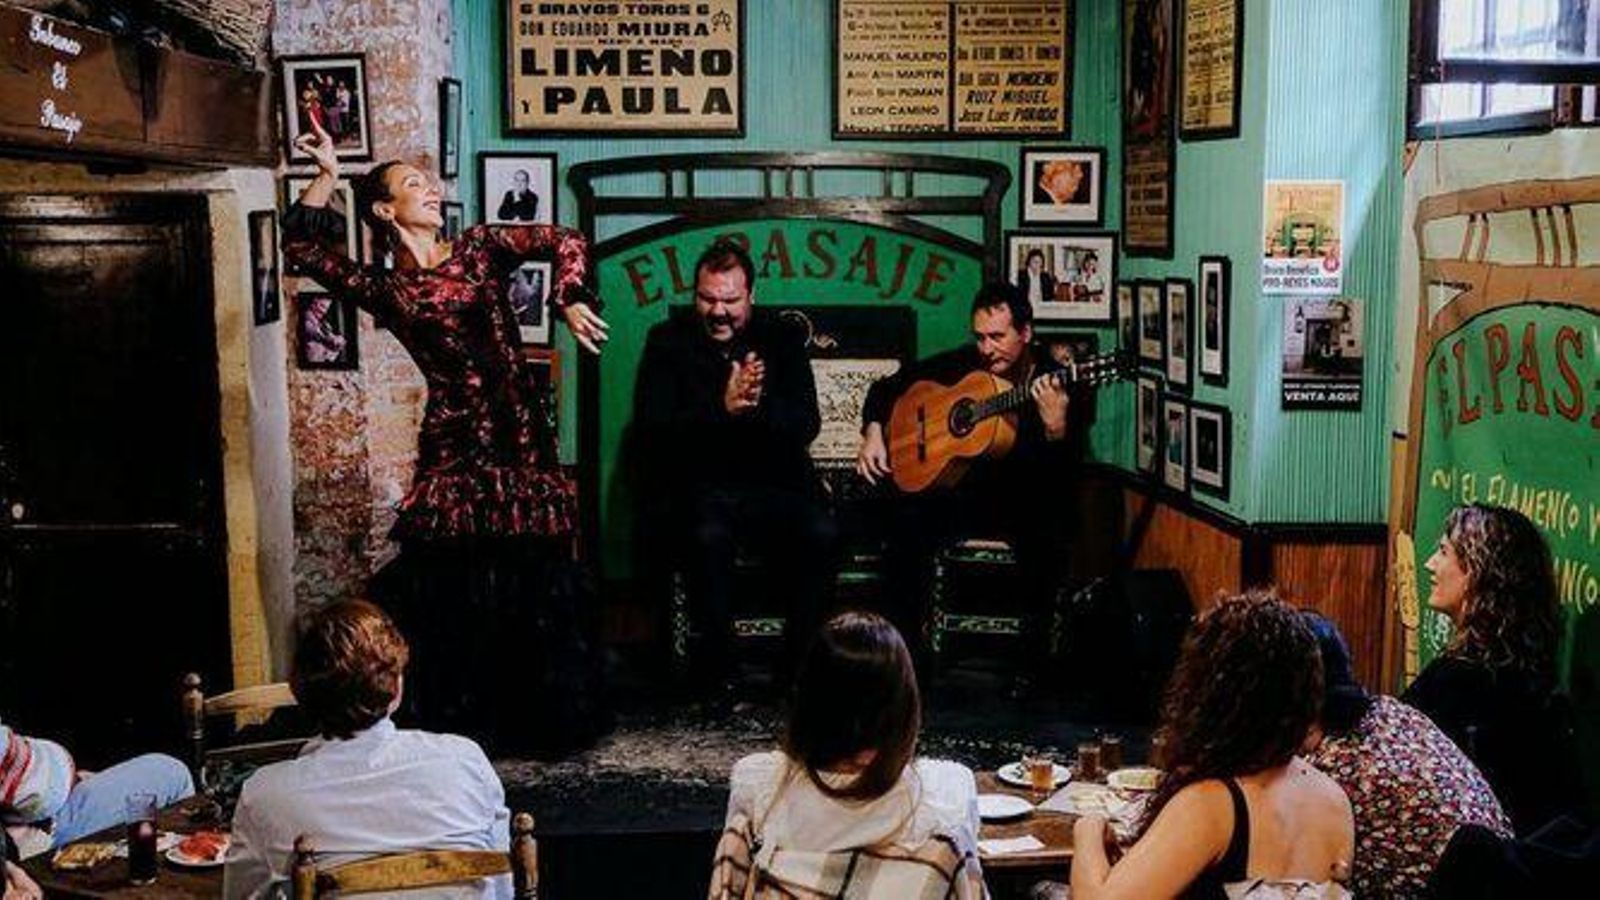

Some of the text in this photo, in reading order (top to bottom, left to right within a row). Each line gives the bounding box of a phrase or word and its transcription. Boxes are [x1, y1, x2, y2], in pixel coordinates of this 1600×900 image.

[538, 3, 620, 15] BRAVOS
[627, 3, 691, 15] TOROS
[552, 22, 609, 36] EDUARDO
[617, 22, 710, 36] MIURA
[843, 52, 891, 61] MANUEL
[896, 70, 945, 79] MARTIN
[543, 87, 733, 114] PAULA
[1002, 89, 1050, 104] MIGUEL
[621, 244, 695, 309] EL
[1485, 322, 1600, 430] PAS
[1284, 390, 1327, 402] VENTA
